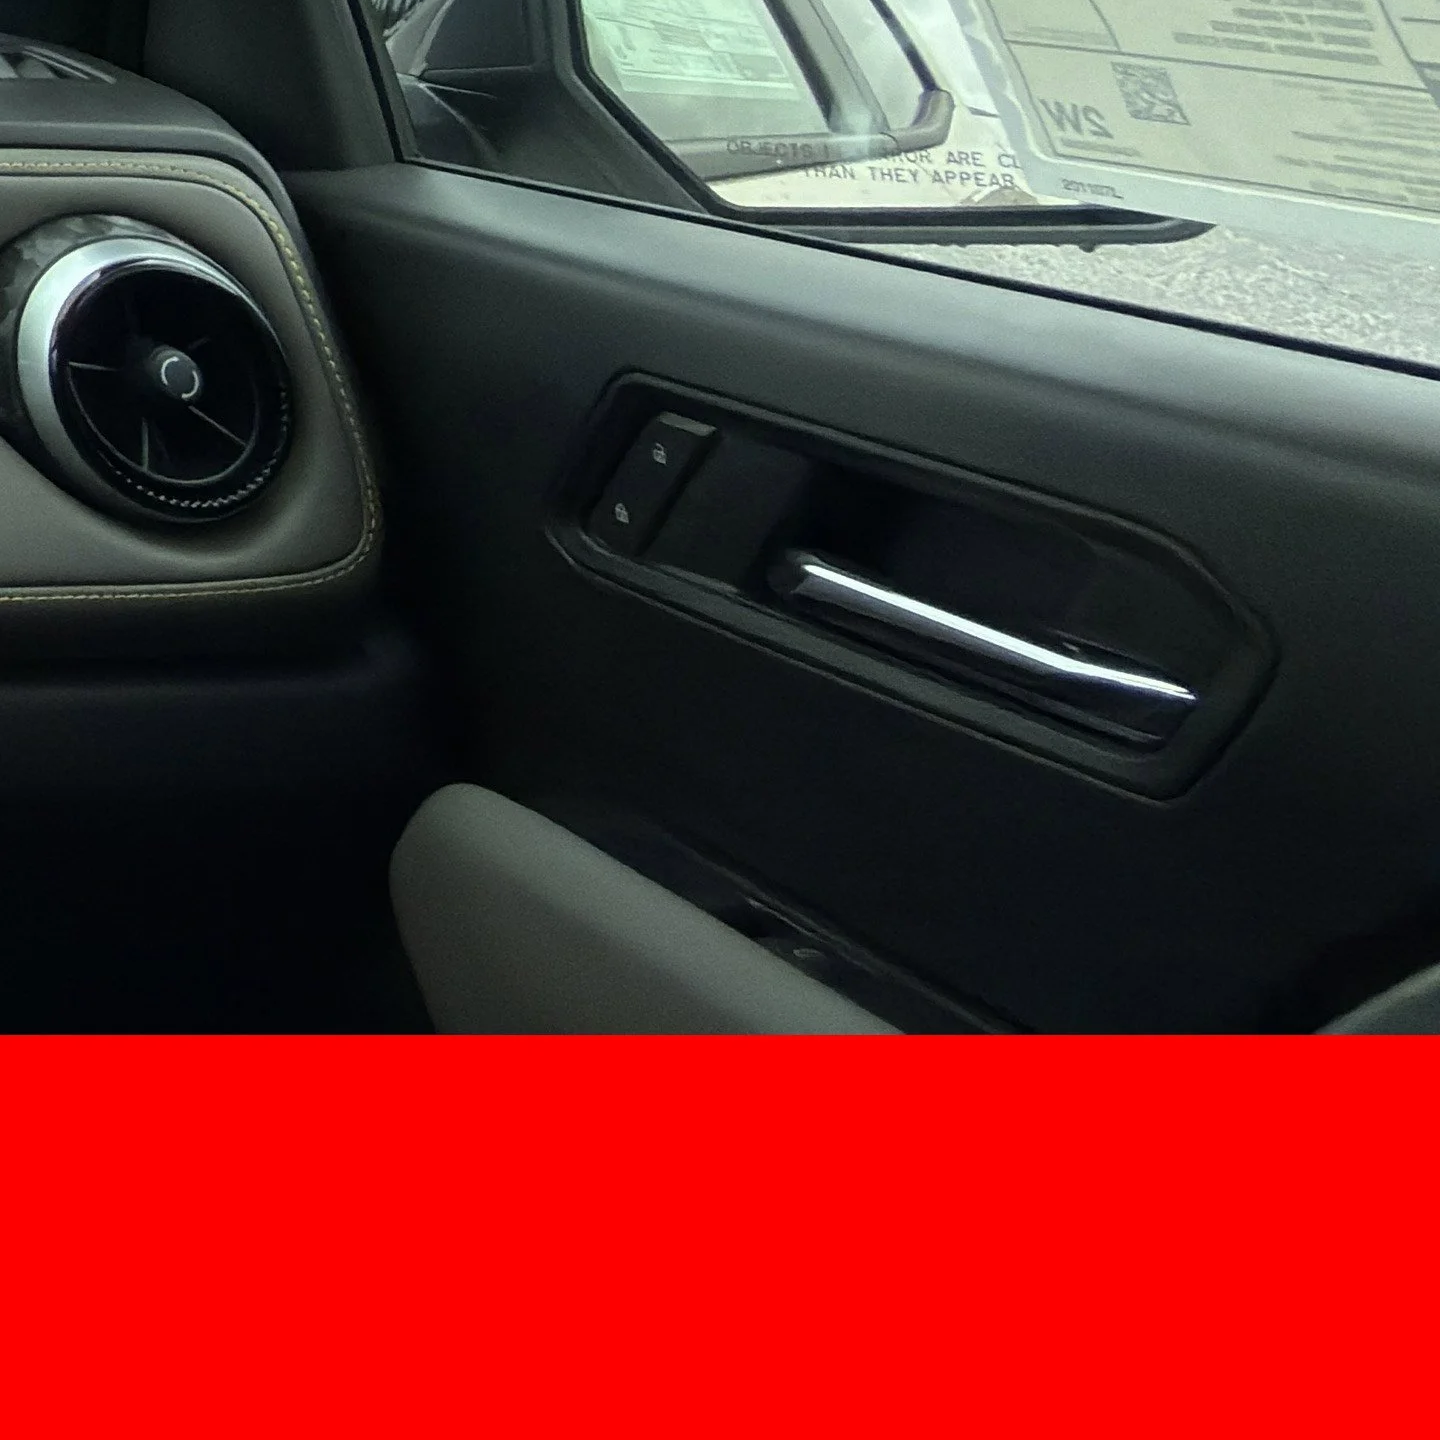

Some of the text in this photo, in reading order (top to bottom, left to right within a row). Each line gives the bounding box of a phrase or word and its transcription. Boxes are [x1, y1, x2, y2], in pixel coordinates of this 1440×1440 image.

[727, 141, 813, 159] OBJECTS
[946, 151, 985, 168] ARE
[868, 166, 920, 183] THEY
[931, 170, 1015, 188] APPEAR
